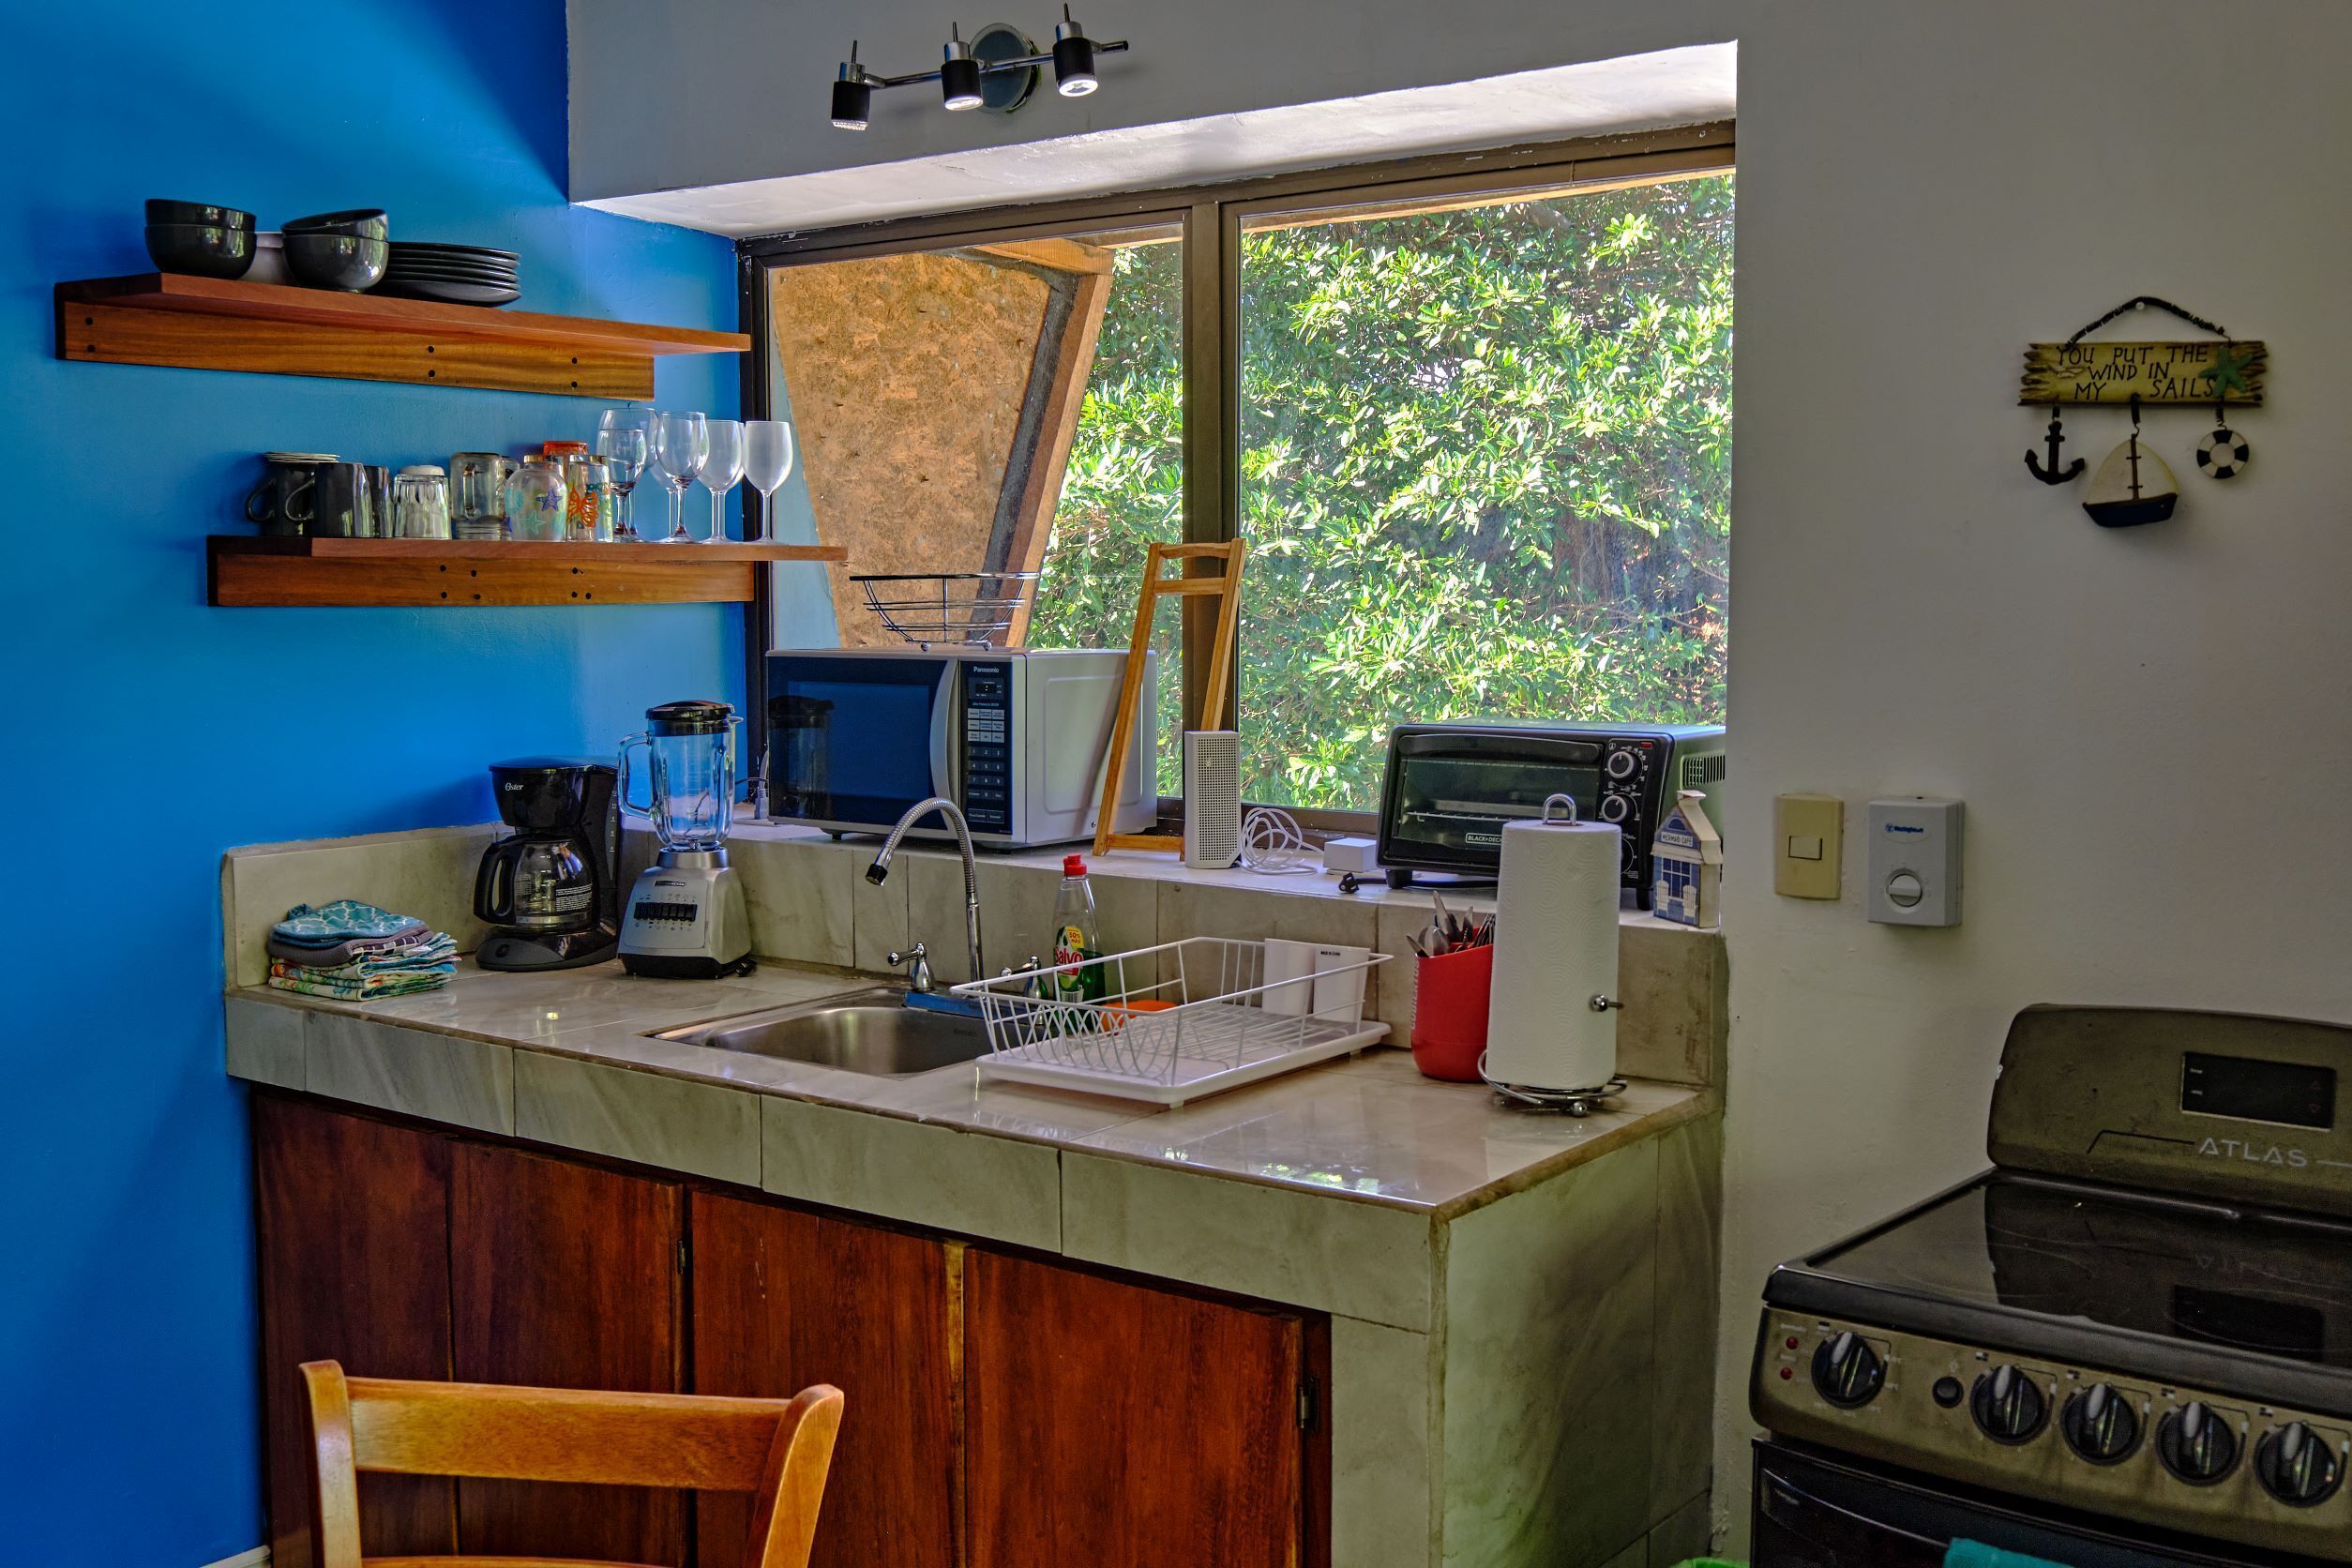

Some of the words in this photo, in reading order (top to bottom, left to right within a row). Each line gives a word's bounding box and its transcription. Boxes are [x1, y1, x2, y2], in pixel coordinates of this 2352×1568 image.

[2056, 345, 2095, 366] YOU
[2112, 346, 2154, 365] PUT
[2165, 344, 2209, 364] THE
[2088, 364, 2138, 381] WIND
[2148, 362, 2170, 380] IN
[2074, 382, 2107, 400] MY
[2149, 377, 2217, 400] SAILS
[505, 782, 524, 792] Oster
[2198, 1137, 2308, 1168] ATLAS
